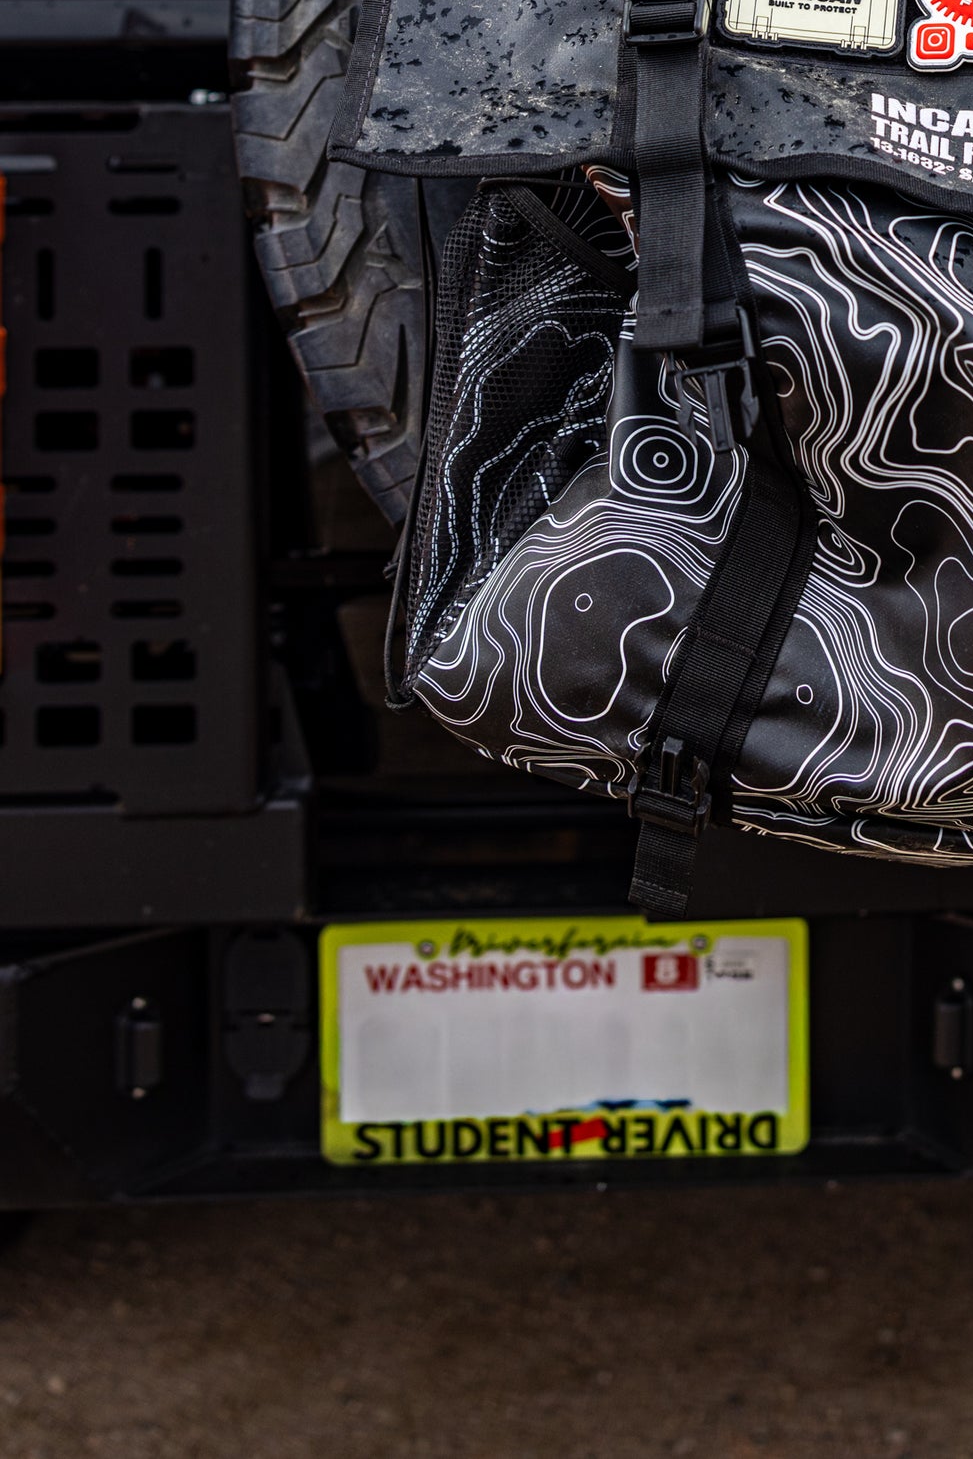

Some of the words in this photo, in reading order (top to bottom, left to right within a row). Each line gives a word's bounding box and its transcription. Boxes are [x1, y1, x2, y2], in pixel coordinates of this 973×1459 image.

[768, 0, 795, 9] BUILT
[797, 2, 811, 11] TO
[813, 4, 858, 14] PROTECT
[870, 115, 956, 162] TRAIL
[364, 959, 616, 993] WASHINGTON
[352, 1117, 585, 1161] STUDENT
[601, 1112, 779, 1154] DRIVER
